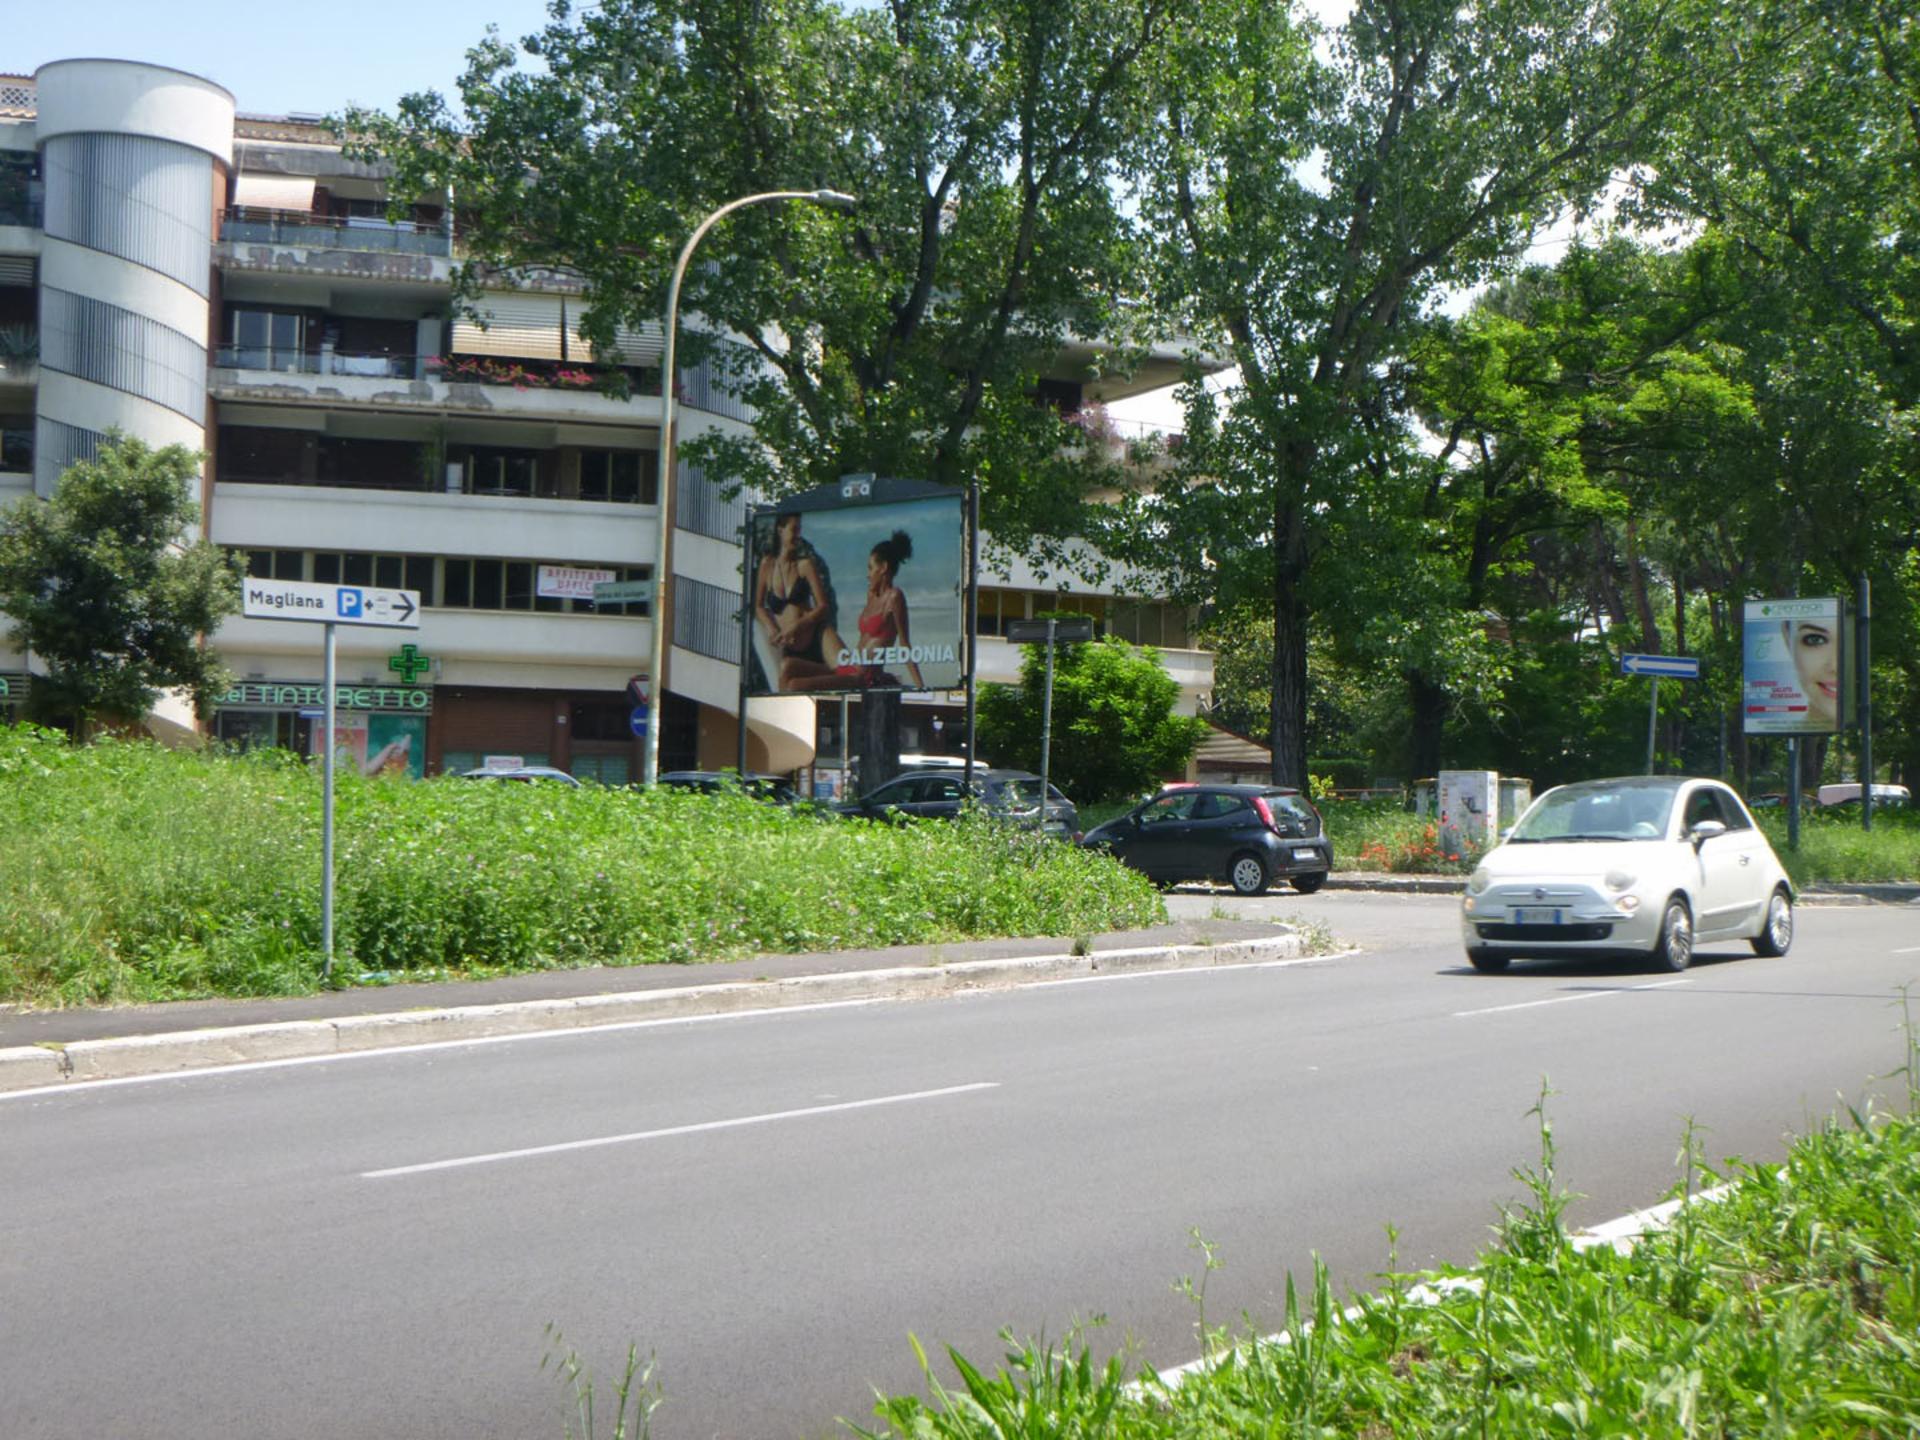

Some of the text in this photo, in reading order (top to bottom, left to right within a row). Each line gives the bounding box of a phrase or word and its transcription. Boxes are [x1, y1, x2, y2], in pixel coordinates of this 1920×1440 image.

[557, 579, 594, 592] UFFIC
[250, 589, 358, 614] Magliana P
[837, 644, 955, 666] CALZEDONIA
